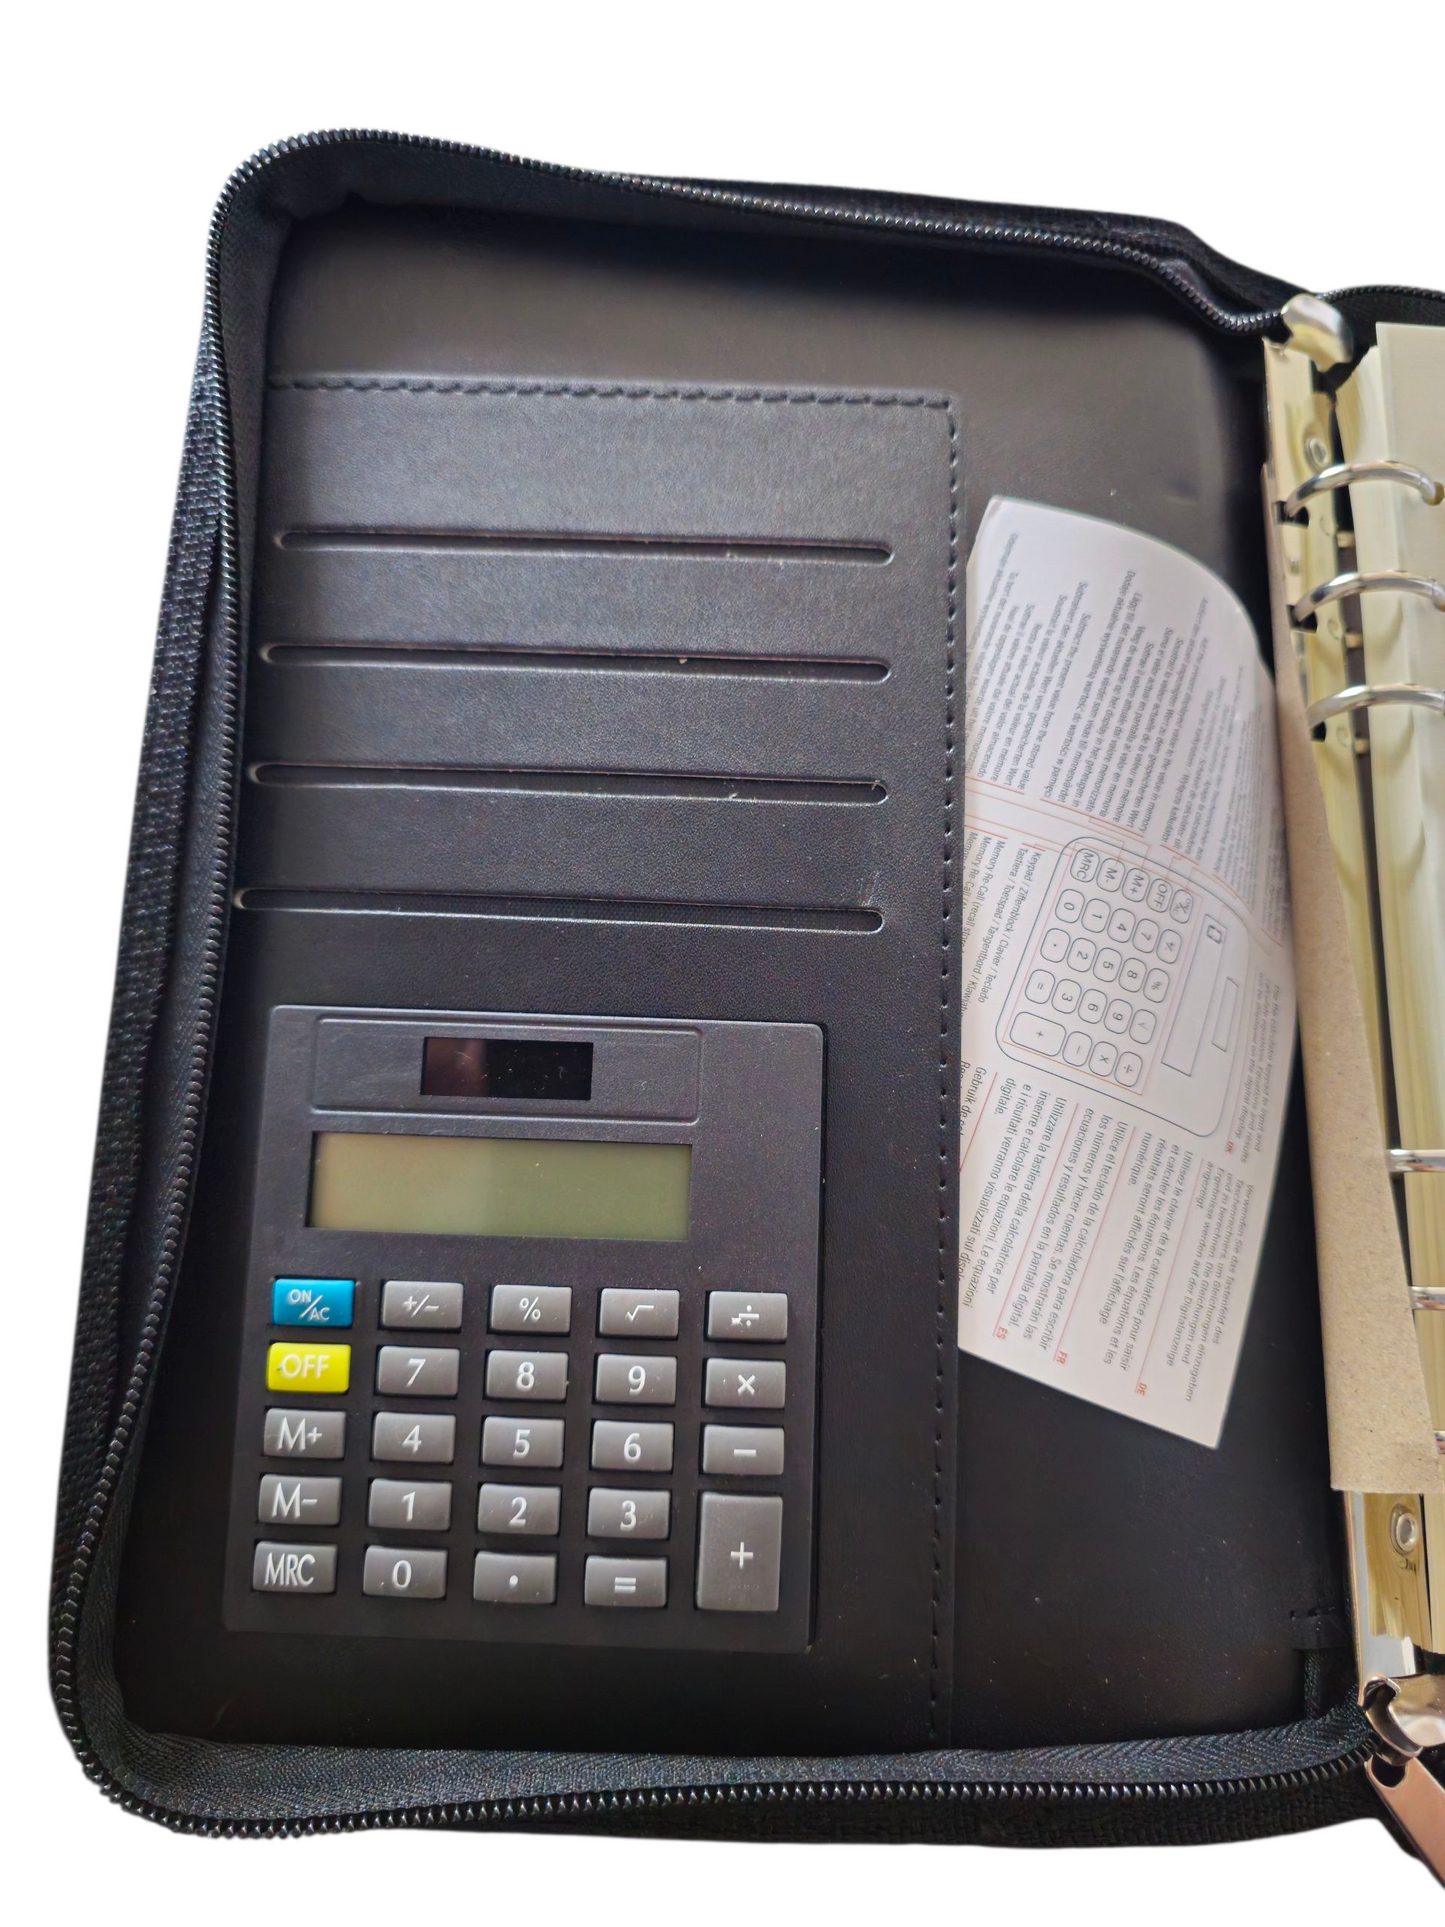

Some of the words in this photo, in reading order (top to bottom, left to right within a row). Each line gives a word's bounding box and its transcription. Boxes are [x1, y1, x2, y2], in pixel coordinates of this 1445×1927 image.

[1072, 613, 1091, 646] Subtract
[1067, 646, 1079, 659] the
[1056, 659, 1072, 689] present
[1048, 689, 1061, 710] value
[1041, 711, 1055, 729] from
[1035, 730, 1047, 743] the
[1026, 743, 1041, 769] stored
[1017, 769, 1031, 790] value
[971, 836, 992, 868] Memory
[985, 840, 1006, 872] Memory
[1009, 848, 1029, 877] Tastiera
[1077, 851, 1095, 879] MRC
[1024, 852, 1042, 882] Keypad
[1105, 866, 1118, 884] M-
[975, 872, 994, 901] Re-Call
[1130, 874, 1145, 895] M+
[1153, 883, 1168, 909] OFF
[966, 901, 982, 927] (recall
[994, 885, 1015, 919] Toetspad
[1004, 887, 1029, 933] Ziffernblock
[1063, 902, 1075, 911] 0
[1117, 922, 1127, 932] 4
[1142, 931, 1152, 941] 7
[973, 926, 999, 975] Tangentbord
[992, 939, 1009, 967] Clavier
[1077, 950, 1088, 960] 2
[1102, 960, 1113, 970] 5
[1128, 969, 1138, 979] 8
[977, 974, 997, 1003] Teclado
[1062, 992, 1073, 1002] 3
[1088, 1003, 1098, 1012] 6
[1113, 1012, 1123, 1022] 9
[964, 1067, 987, 1104] Gebruik
[994, 1078, 1016, 1114] digitale.
[1006, 1097, 1028, 1134] risultati
[1028, 1090, 1051, 1127] inserire
[1042, 1097, 1067, 1141] Utilizzare
[1098, 1114, 1113, 1130] los
[1025, 1128, 1034, 1136] e
[1068, 1108, 1094, 1164] ecuaciones
[1109, 1121, 1128, 1152] Utilice
[990, 1136, 1013, 1179] verranno
[1008, 1137, 1031, 1181] calcolare
[1037, 1142, 1051, 1153] la
[1083, 1131, 1104, 1174] números
[1105, 1153, 1116, 1165] el
[1128, 1132, 1152, 1185] numérique.
[1147, 1138, 1166, 1181] résultats
[1170, 1144, 1180, 1155] et
[1024, 1154, 1046, 1191] tastiera
[1062, 1164, 1074, 1173] y
[1077, 1174, 1089, 1183] y
[1092, 1164, 1112, 1201] teclado
[1159, 1156, 1176, 1195] calculer
[1176, 1151, 1194, 1186] Utilisez
[1224, 1172, 1233, 1193] und
[1004, 1182, 1017, 1193] le
[1046, 1173, 1071, 1225] resultados
[1069, 1183, 1089, 1213] hacer
[1136, 1182, 1152, 1214] seront
[1173, 1186, 1184, 1197] le
[970, 1181, 996, 1235] visualizzati
[985, 1194, 1010, 1242] equazioni.
[1014, 1192, 1031, 1217] della
[1086, 1202, 1099, 1216] de
[1153, 1196, 1166, 1212] les
[1163, 1198, 1179, 1231] clavier
[1040, 1226, 1052, 1240] en
[1054, 1213, 1075, 1254] cuentas.
[1082, 1216, 1096, 1227] la
[1123, 1215, 1142, 1254] affichés
[963, 1235, 976, 1253] sul
[980, 1244, 994, 1258] Le
[993, 1218, 1020, 1275] calcolatrice
[1036, 1240, 1049, 1251] la
[1137, 1213, 1160, 1262] équations.
[1155, 1246, 1166, 1257] la
[1158, 1232, 1170, 1245] de
[1196, 1222, 1210, 1258] werden
[1048, 1256, 1062, 1270] Se
[1062, 1228, 1088, 1286] calculadora
[1117, 1255, 1129, 1273] sur
[1191, 1259, 1201, 1278] auf
[1203, 1261, 1214, 1278] Die
[962, 1259, 986, 1307] equazioni
[986, 1275, 999, 1294] per
[1021, 1251, 1042, 1292] pantalla
[1130, 1265, 1144, 1284] Les
[1029, 1271, 1054, 1322] mostrarán
[1053, 1286, 1067, 1310] para
[1099, 1273, 1125, 1324] l'affichage
[1137, 1258, 1160, 1316] calculatrice
[1187, 1277, 1197, 1295] der
[520, 1298, 541, 1320] %
[1008, 1294, 1029, 1327] digital.
[1113, 1285, 1137, 1335] équations
[996, 1327, 1008, 1339] ES
[1023, 1324, 1038, 1339] las
[1039, 1312, 1058, 1350] escribir
[1109, 1336, 1119, 1348] et
[1129, 1316, 1142, 1342] pour
[280, 1354, 330, 1379] OFF
[1055, 1351, 1068, 1364] FR
[1103, 1348, 1118, 1364] les
[1119, 1342, 1134, 1371] saisir
[1181, 1343, 1192, 1365] und
[406, 1358, 426, 1388] 7
[516, 1362, 535, 1389] 8
[628, 1366, 646, 1394] 9
[1137, 1382, 1147, 1396] DE
[277, 1417, 322, 1451] M+
[403, 1426, 422, 1453] 4
[514, 1428, 530, 1456] 5
[624, 1433, 641, 1461] 6
[273, 1483, 318, 1516] M-
[402, 1492, 415, 1521] 1
[509, 1497, 527, 1527] 2
[621, 1501, 637, 1530] 3
[265, 1554, 315, 1585] MRC
[730, 1543, 753, 1569] +
[393, 1560, 411, 1588] 0
